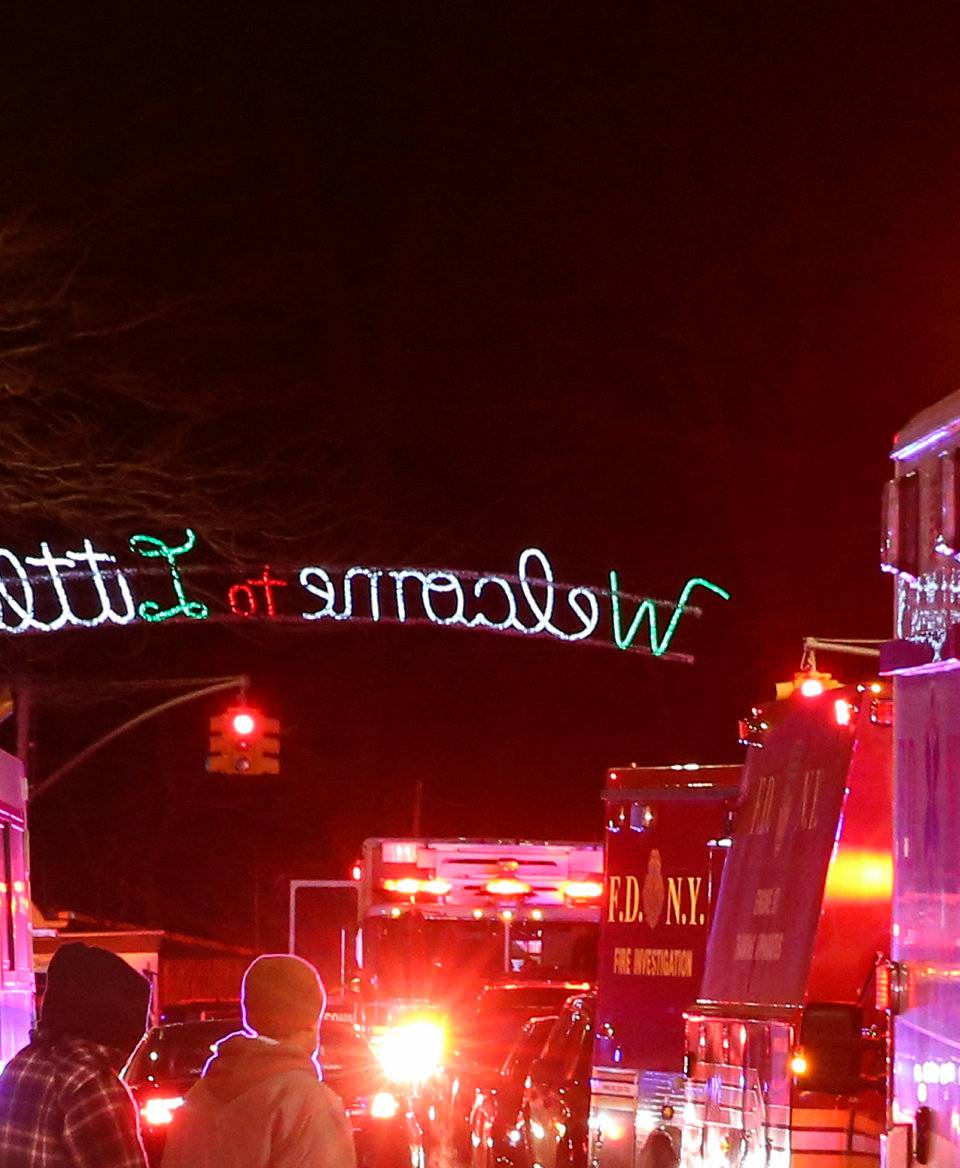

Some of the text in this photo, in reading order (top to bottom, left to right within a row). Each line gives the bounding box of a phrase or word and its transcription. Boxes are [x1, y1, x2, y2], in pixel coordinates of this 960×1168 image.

[607, 875, 644, 924] F.D.
[664, 876, 706, 926] N.Y.
[613, 946, 632, 975] FIRE
